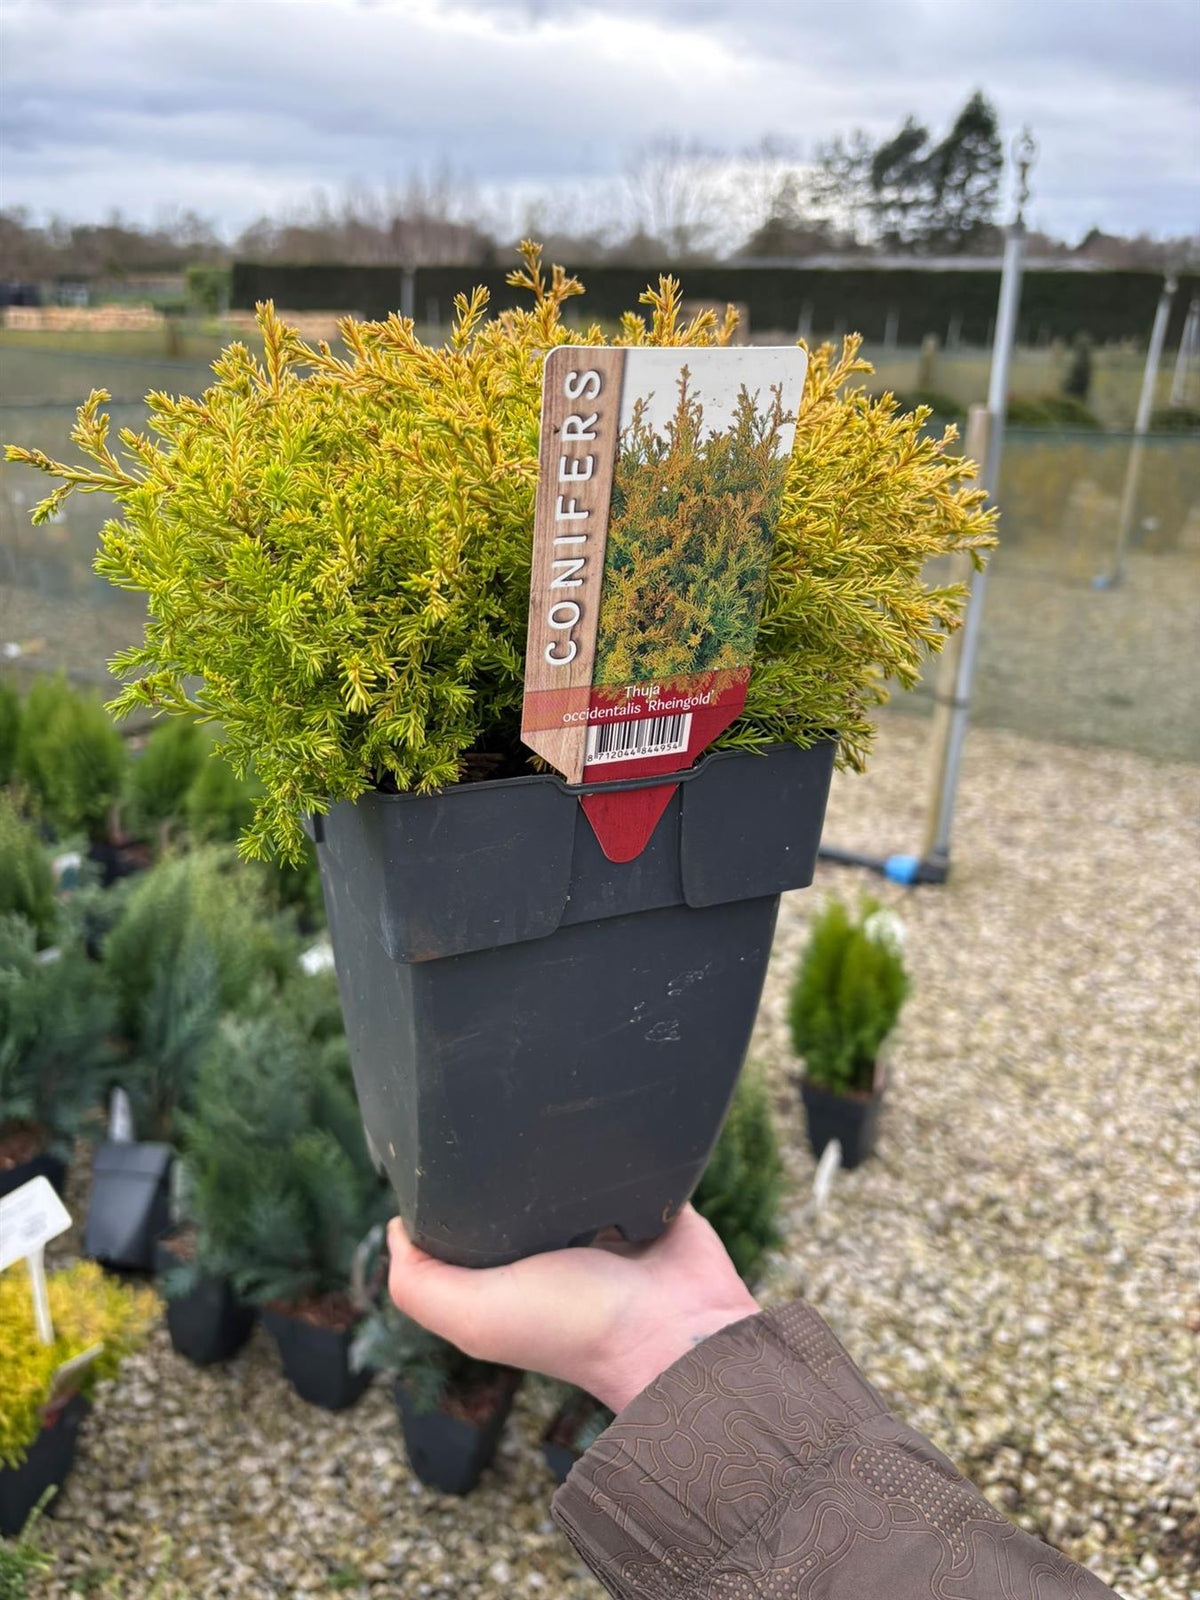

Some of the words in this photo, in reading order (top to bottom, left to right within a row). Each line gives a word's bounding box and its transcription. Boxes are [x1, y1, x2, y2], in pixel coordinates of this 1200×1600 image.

[544, 369, 601, 666] CONIFERS
[624, 684, 660, 698] Thuja
[562, 703, 641, 722] occidentalis
